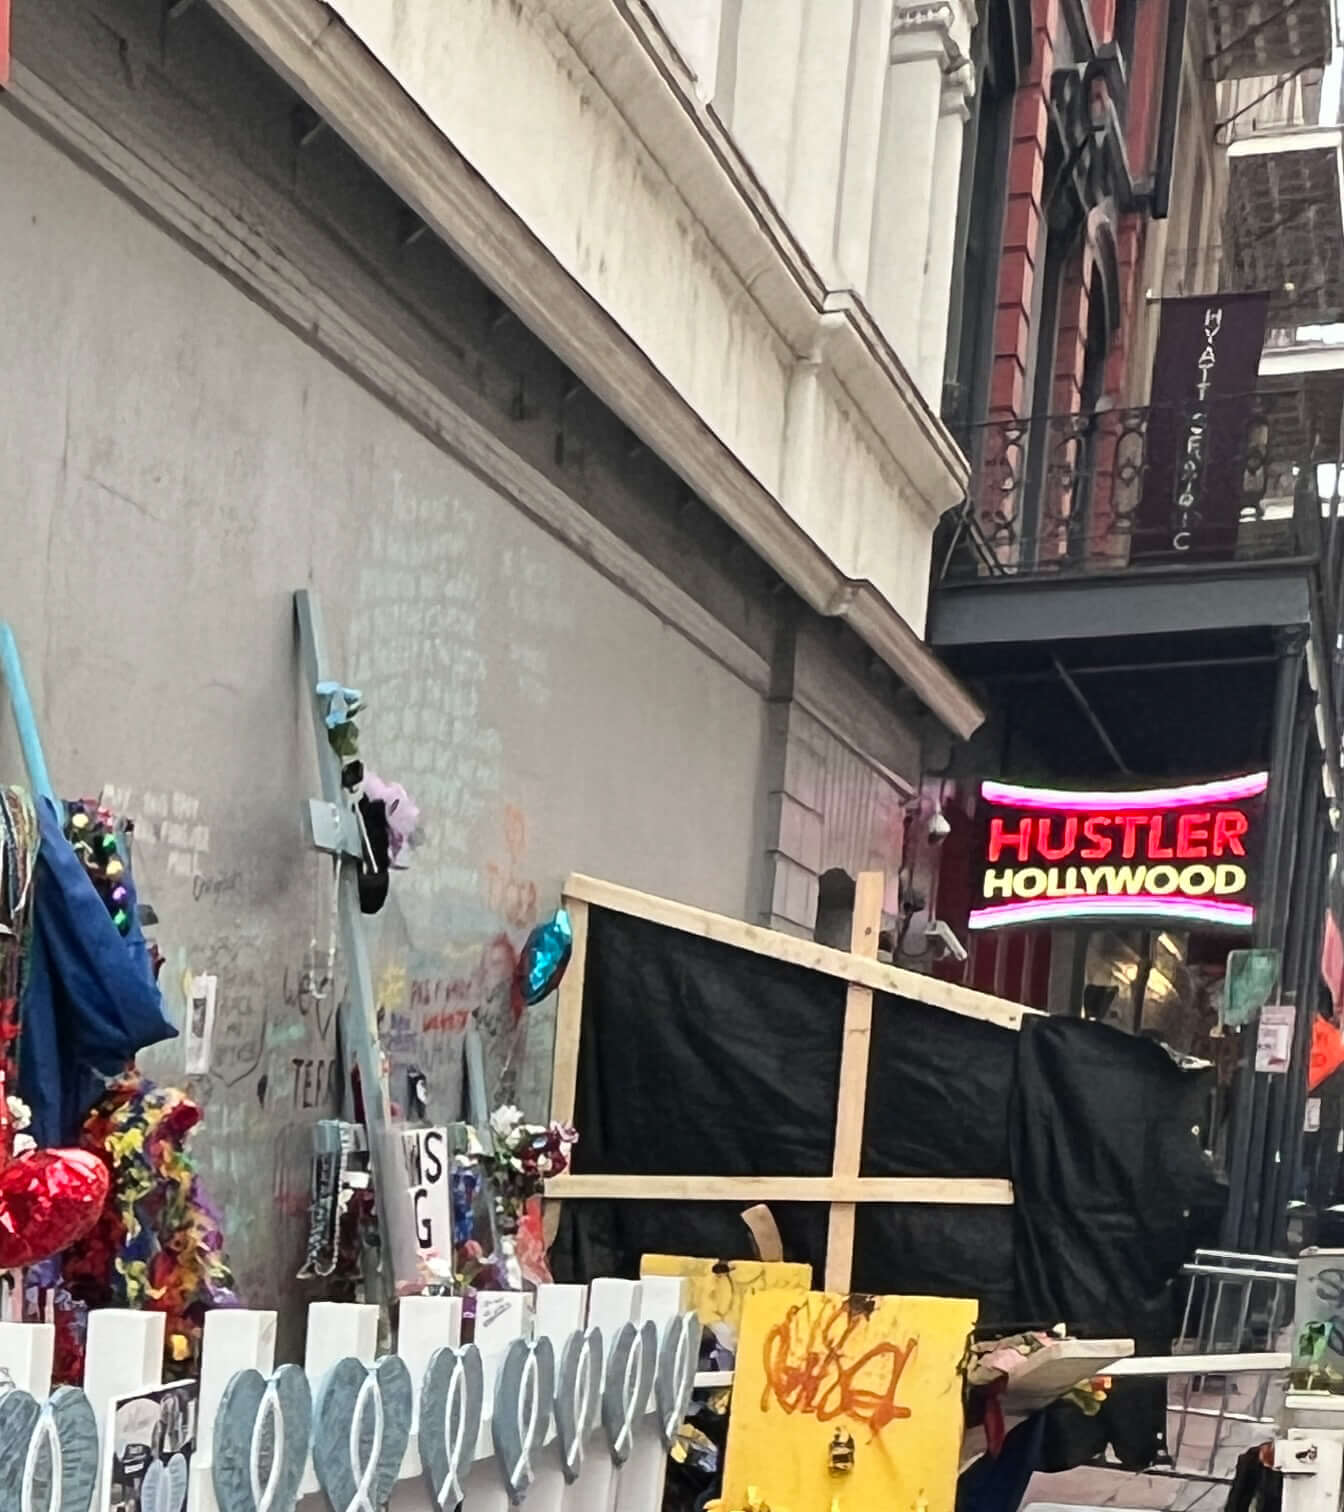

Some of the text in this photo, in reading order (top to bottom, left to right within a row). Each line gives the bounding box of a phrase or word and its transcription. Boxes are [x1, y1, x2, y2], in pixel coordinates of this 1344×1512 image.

[1197, 307, 1223, 402] HYATT
[987, 811, 1249, 863] HUSTLER
[982, 864, 1247, 898] HOLLYWOOD
